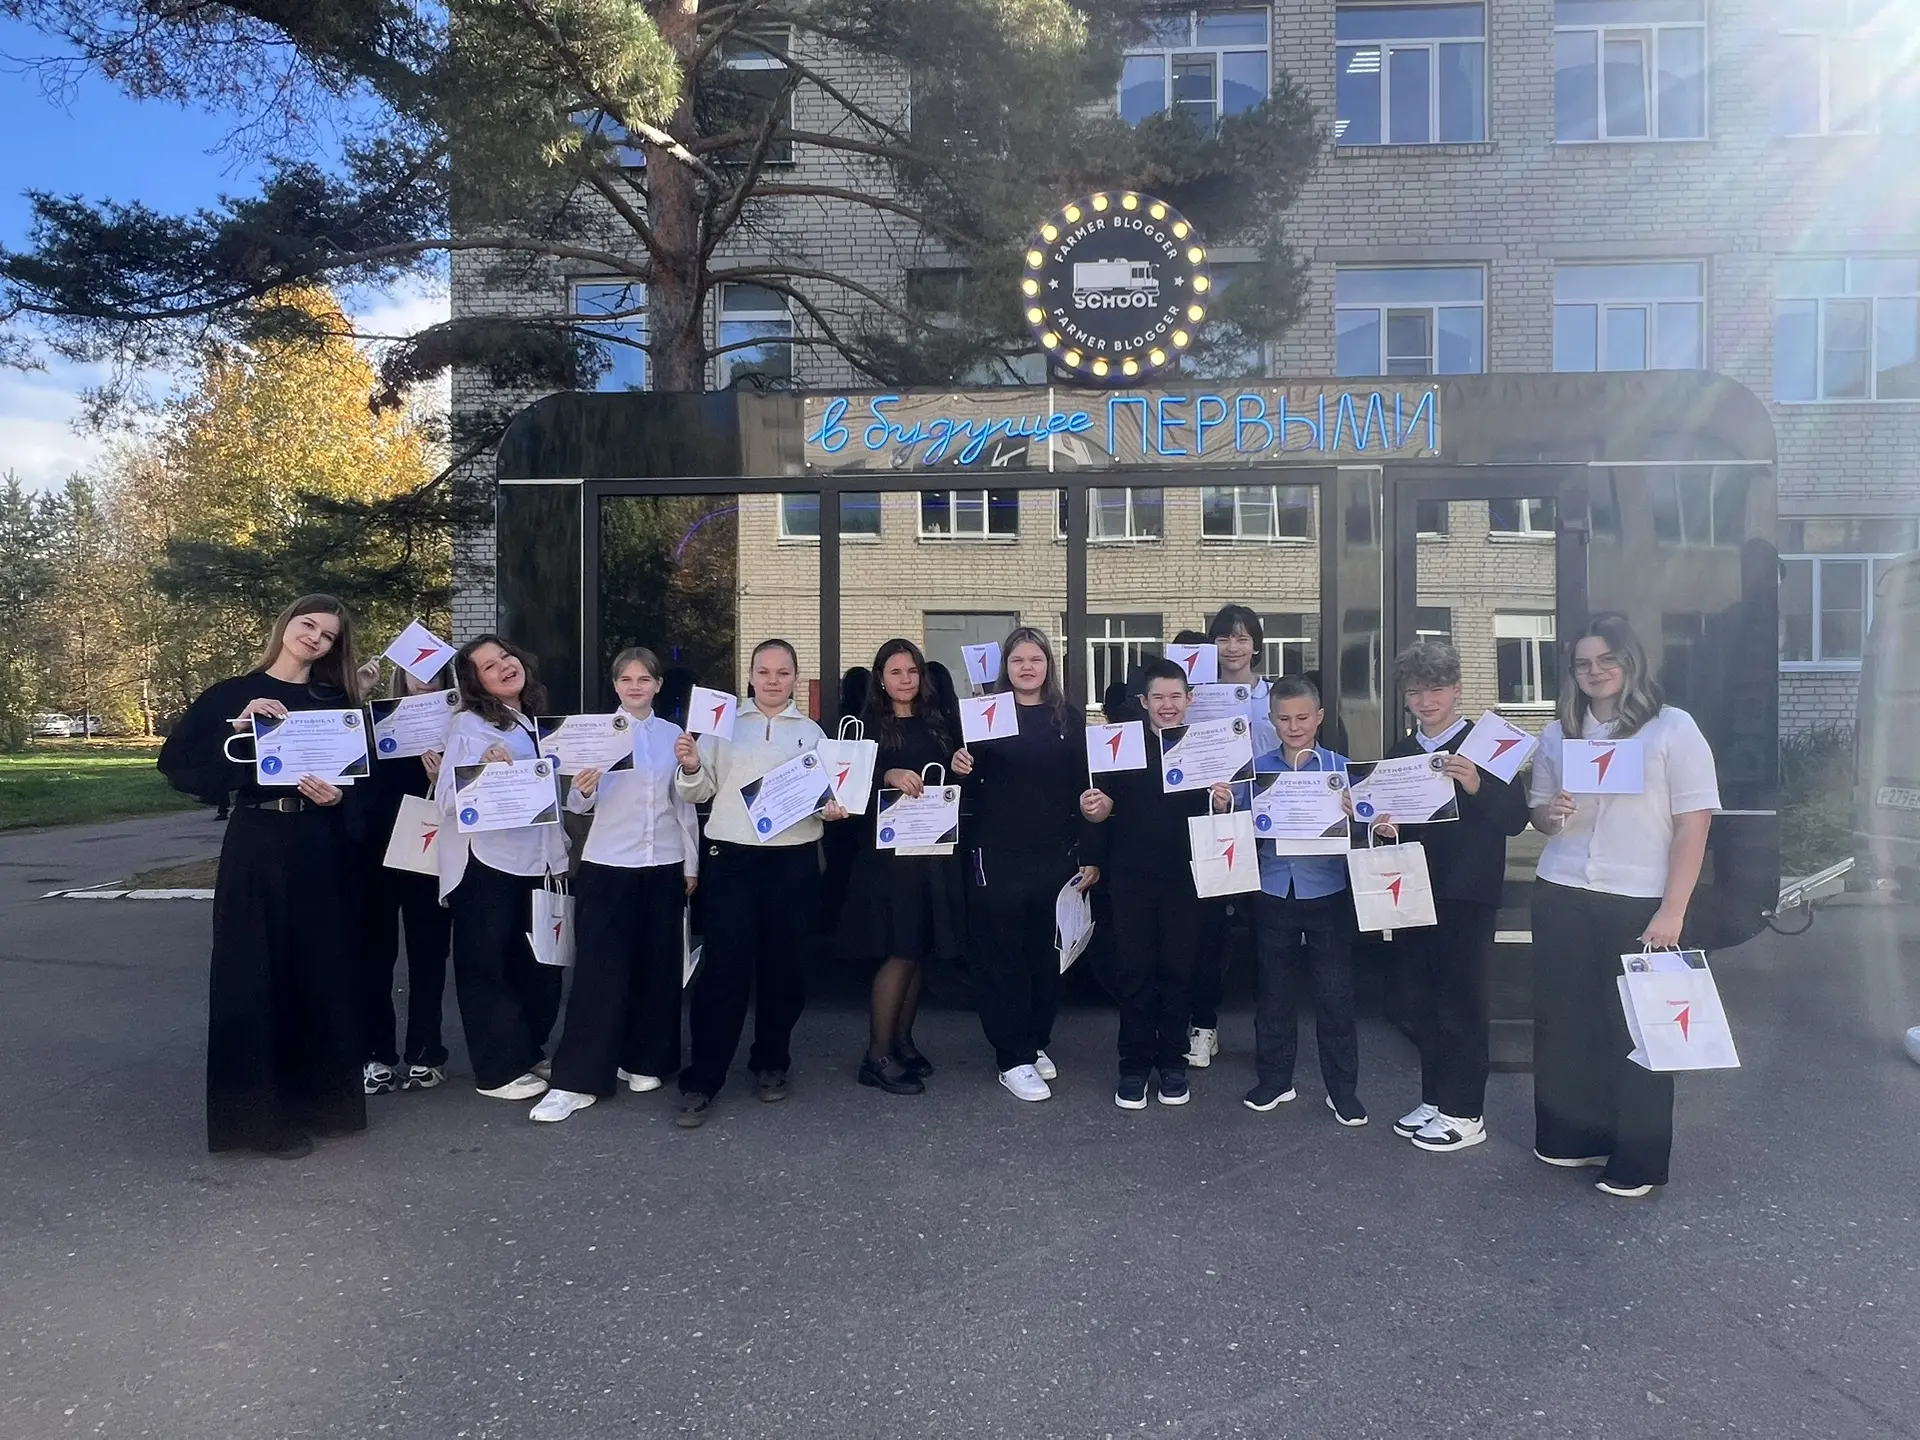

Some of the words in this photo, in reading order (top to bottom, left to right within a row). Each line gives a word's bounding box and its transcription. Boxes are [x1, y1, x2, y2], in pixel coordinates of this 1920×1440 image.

[1054, 218, 1106, 264] FARMER
[1113, 216, 1178, 261] BLOGGER
[1074, 294, 1158, 310] SCHOOL
[1053, 307, 1107, 351] FARMER
[1114, 305, 1180, 352] BLOGGER
[807, 396, 849, 453] в
[863, 394, 1097, 466] будущее
[1108, 391, 1437, 456] ПЕРВЫМИ
